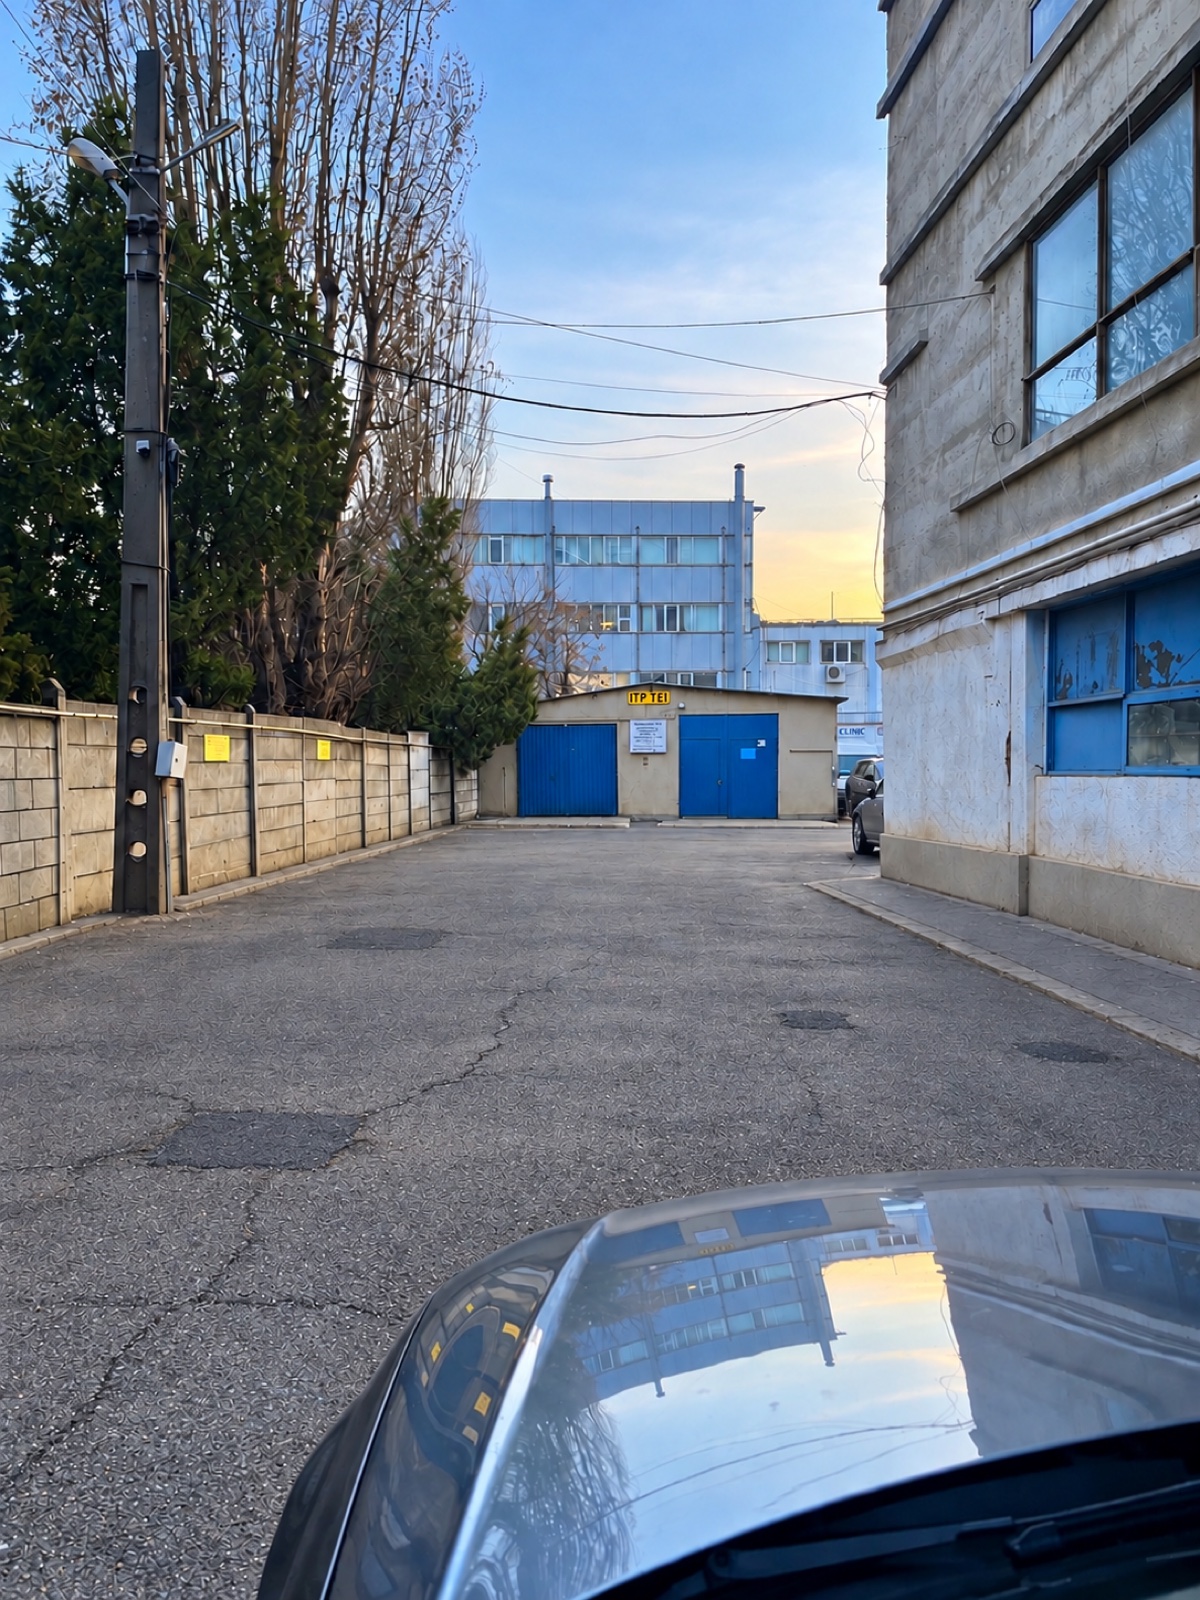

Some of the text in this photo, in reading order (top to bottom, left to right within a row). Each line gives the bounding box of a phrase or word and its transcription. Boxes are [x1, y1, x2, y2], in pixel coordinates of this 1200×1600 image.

[630, 692, 667, 703] ITP TEI
[839, 727, 866, 736] CLINIC
